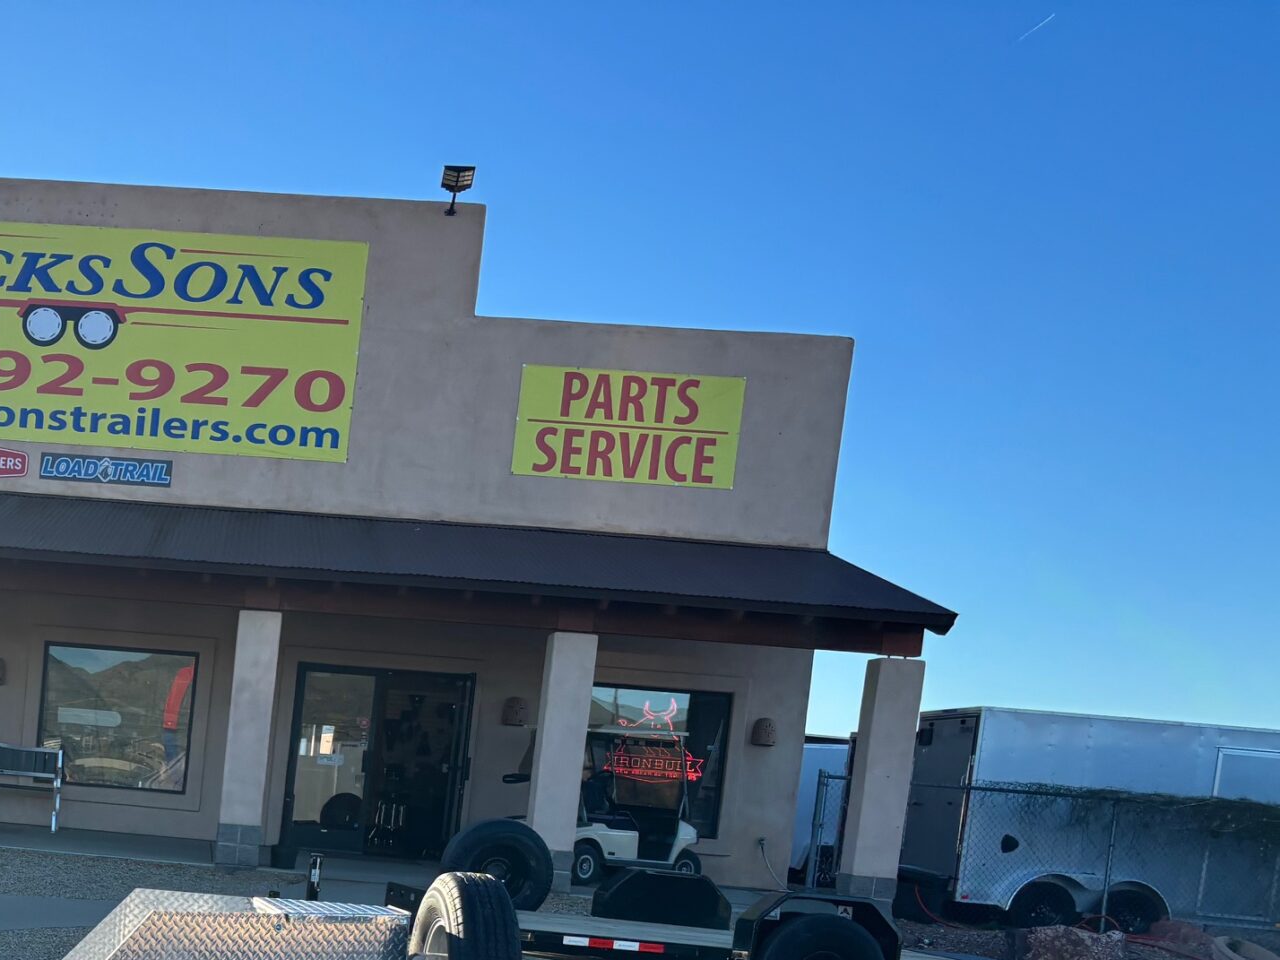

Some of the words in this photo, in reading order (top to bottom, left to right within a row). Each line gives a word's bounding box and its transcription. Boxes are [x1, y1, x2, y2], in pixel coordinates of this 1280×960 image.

[559, 371, 701, 425] PARTS
[40, 456, 99, 478] LOAD
[110, 460, 171, 483] TRAIL
[531, 427, 717, 484] SERVICE
